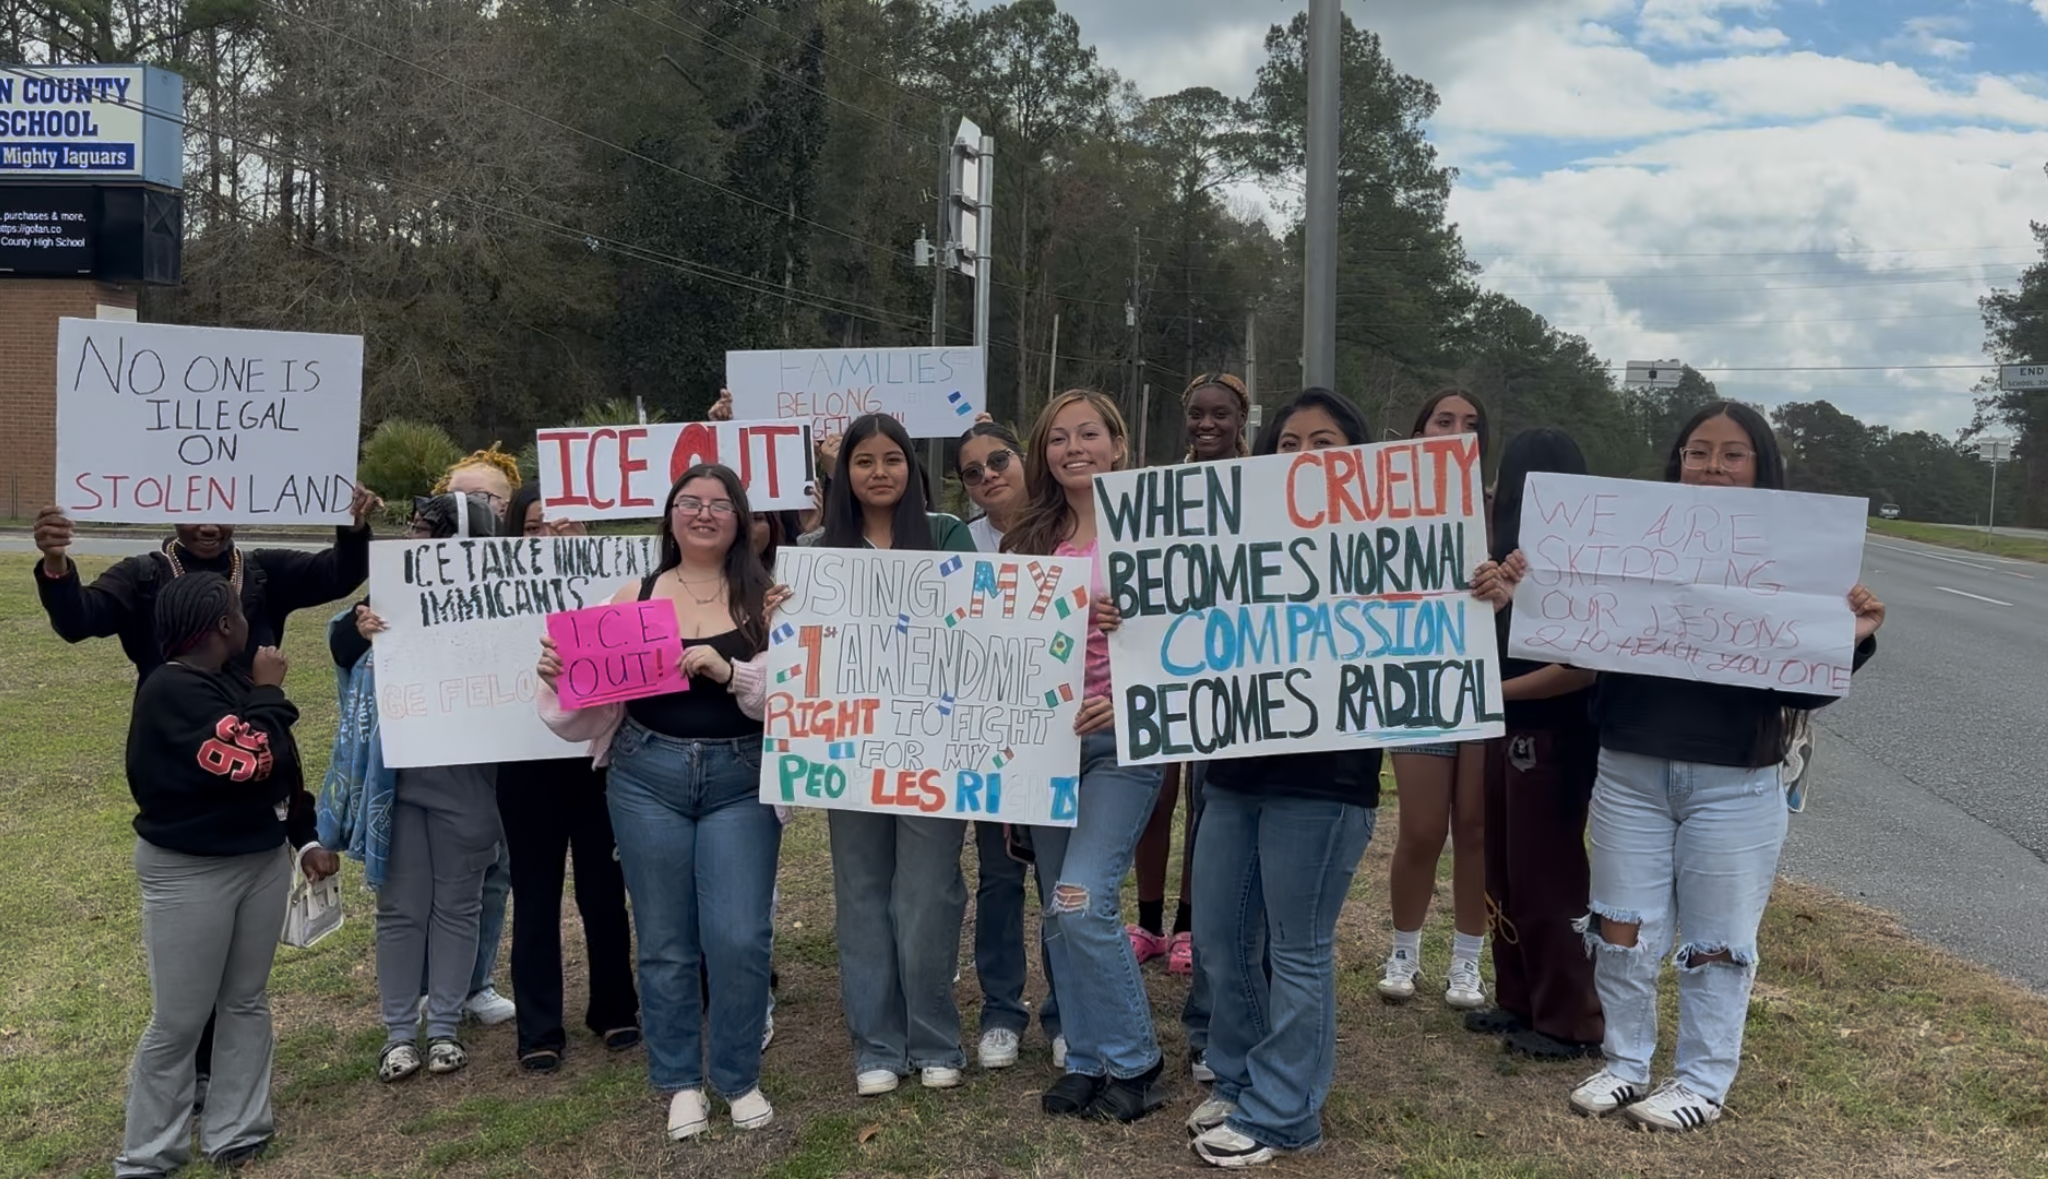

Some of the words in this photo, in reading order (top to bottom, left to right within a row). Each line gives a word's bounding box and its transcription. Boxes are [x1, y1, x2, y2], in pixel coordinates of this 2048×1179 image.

[23, 77, 131, 105] COUNTY
[0, 110, 99, 137] SCHOOL
[3, 147, 57, 168] Mighty
[63, 147, 127, 168] Jaguars
[4, 211, 49, 222] purchases
[51, 211, 59, 220] &
[0, 236, 31, 248] County
[33, 237, 54, 249] High
[55, 237, 85, 247] School
[74, 336, 165, 395] NO
[184, 355, 265, 393] ONE
[279, 360, 320, 392] IS
[780, 350, 954, 390] FAMILIES
[2020, 367, 2044, 376] END
[146, 398, 299, 431] ILLEGAL
[777, 386, 882, 419] BELONG
[178, 433, 237, 465] ON
[538, 428, 654, 510] ICE
[71, 472, 236, 513] STOLEN
[249, 474, 356, 515] LAND
[1094, 465, 1241, 542] WHEN
[1286, 437, 1478, 529] CRUELTY
[1530, 480, 1619, 537] WE
[1642, 504, 1762, 555] ARE
[404, 543, 455, 587] ICE
[460, 538, 543, 582] TAKE
[554, 536, 651, 579] INNOCENT
[1108, 537, 1320, 619] BECOMES
[1330, 522, 1473, 596] NORMAL
[1531, 535, 1785, 596] SKIPPING
[777, 552, 946, 618] USING
[969, 560, 1063, 620] MY
[1541, 590, 1622, 629] OUR
[1160, 600, 1466, 676] COMPASSION
[1524, 625, 1572, 651] 2
[569, 648, 664, 697] OUT!
[766, 691, 880, 742] RIGHT
[891, 700, 943, 737] TO
[951, 704, 1055, 751] FIGHT
[1125, 667, 1318, 760] BECOMES
[1336, 659, 1504, 731] RADICAL
[860, 740, 925, 771] FOR
[943, 744, 989, 771] MY
